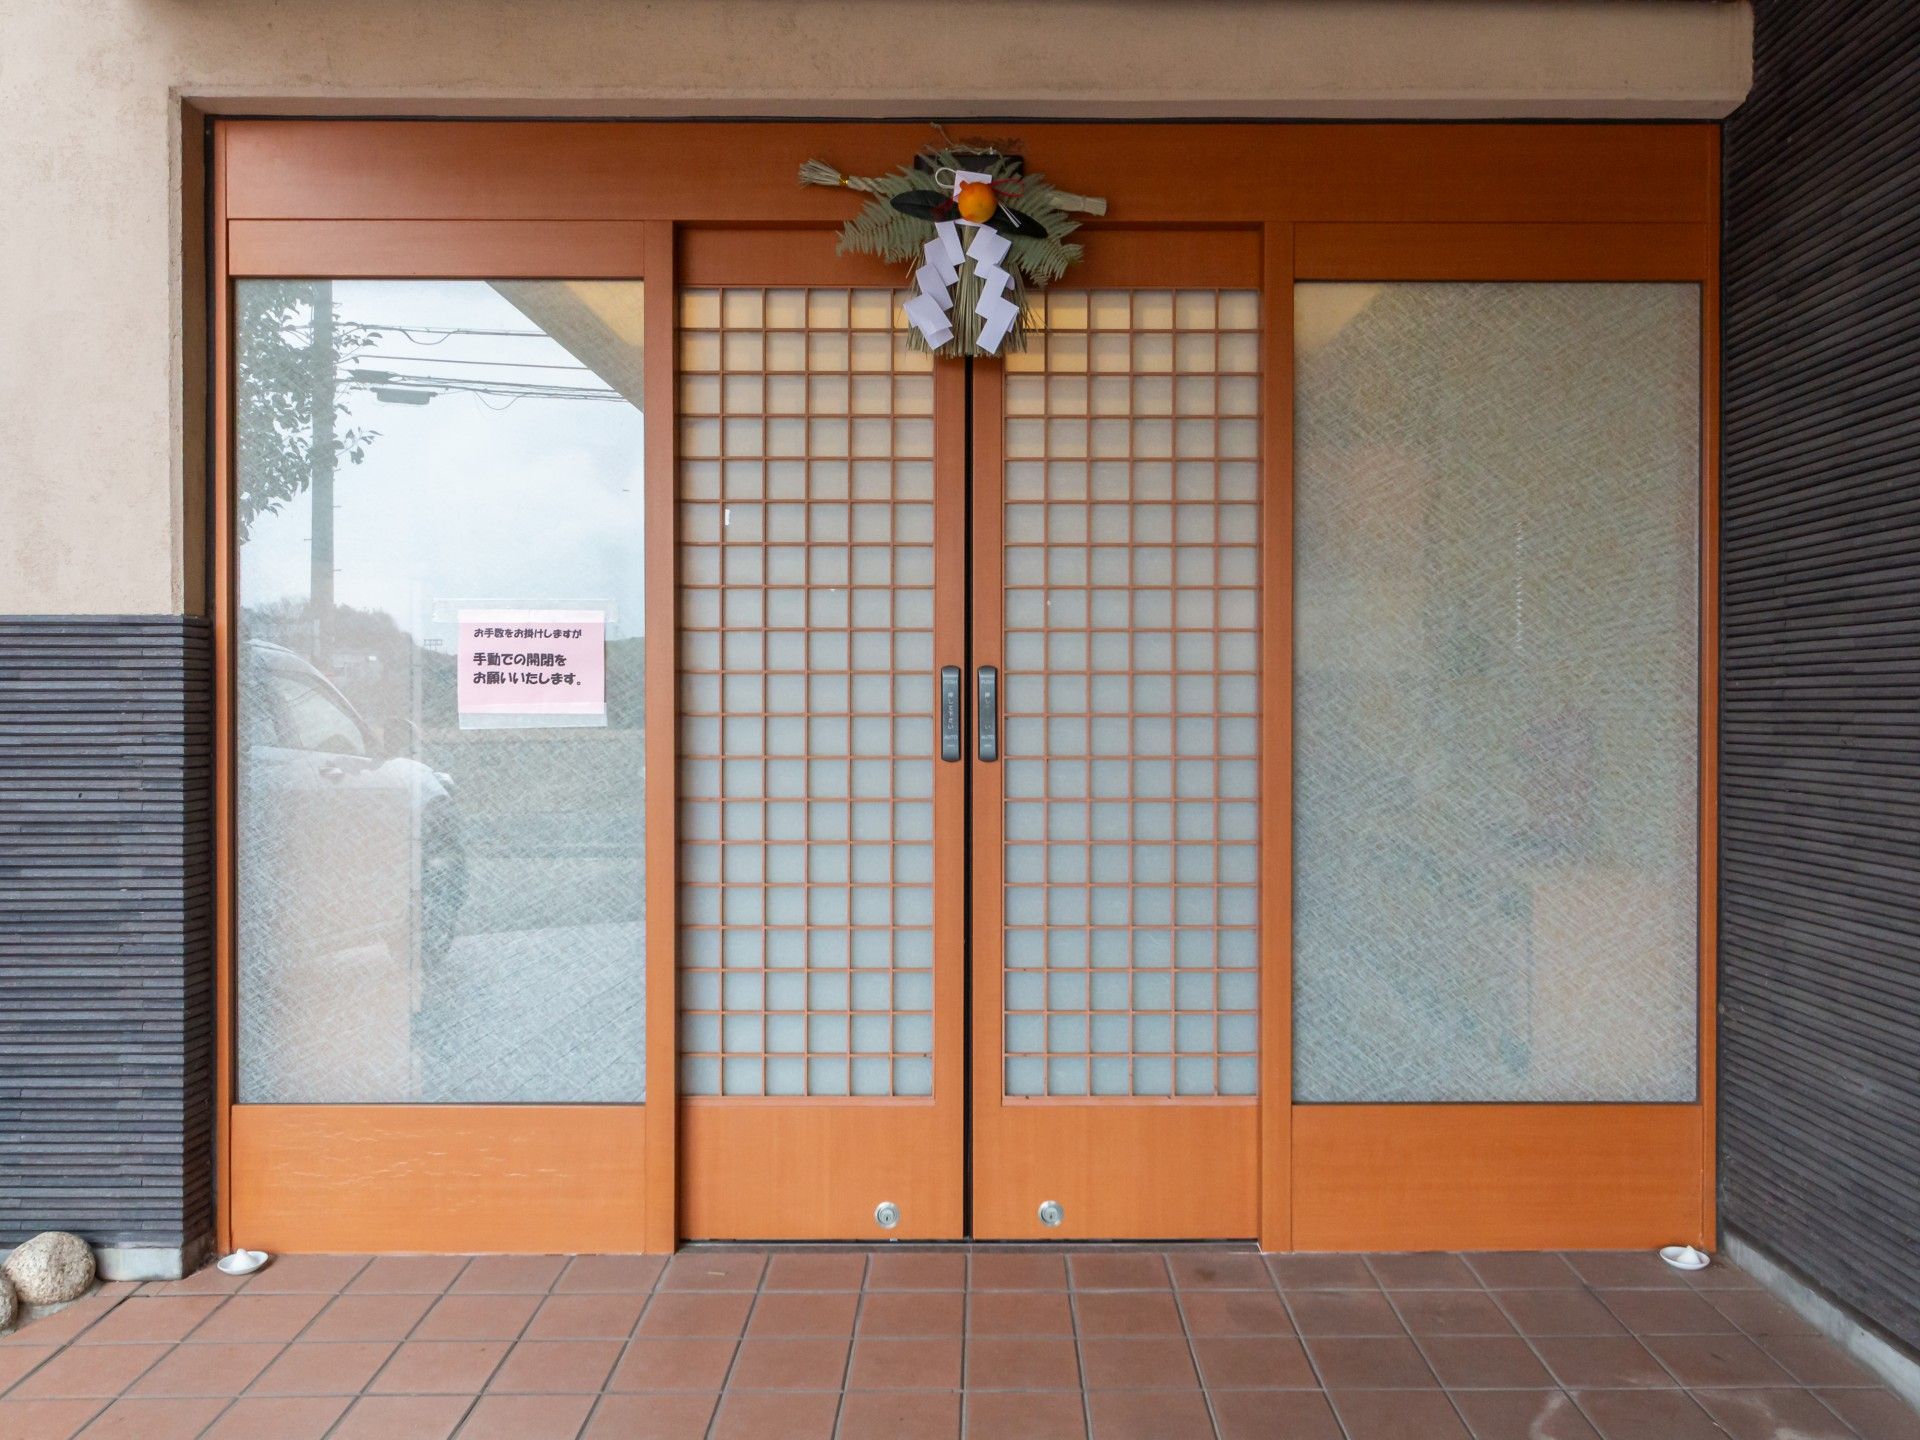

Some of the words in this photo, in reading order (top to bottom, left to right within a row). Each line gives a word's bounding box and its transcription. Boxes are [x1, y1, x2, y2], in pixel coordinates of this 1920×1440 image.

[474, 628, 581, 638] お手数をお掛けしますが
[473, 652, 567, 667] 手動での開閉を
[473, 671, 582, 686] お願いいたします。
